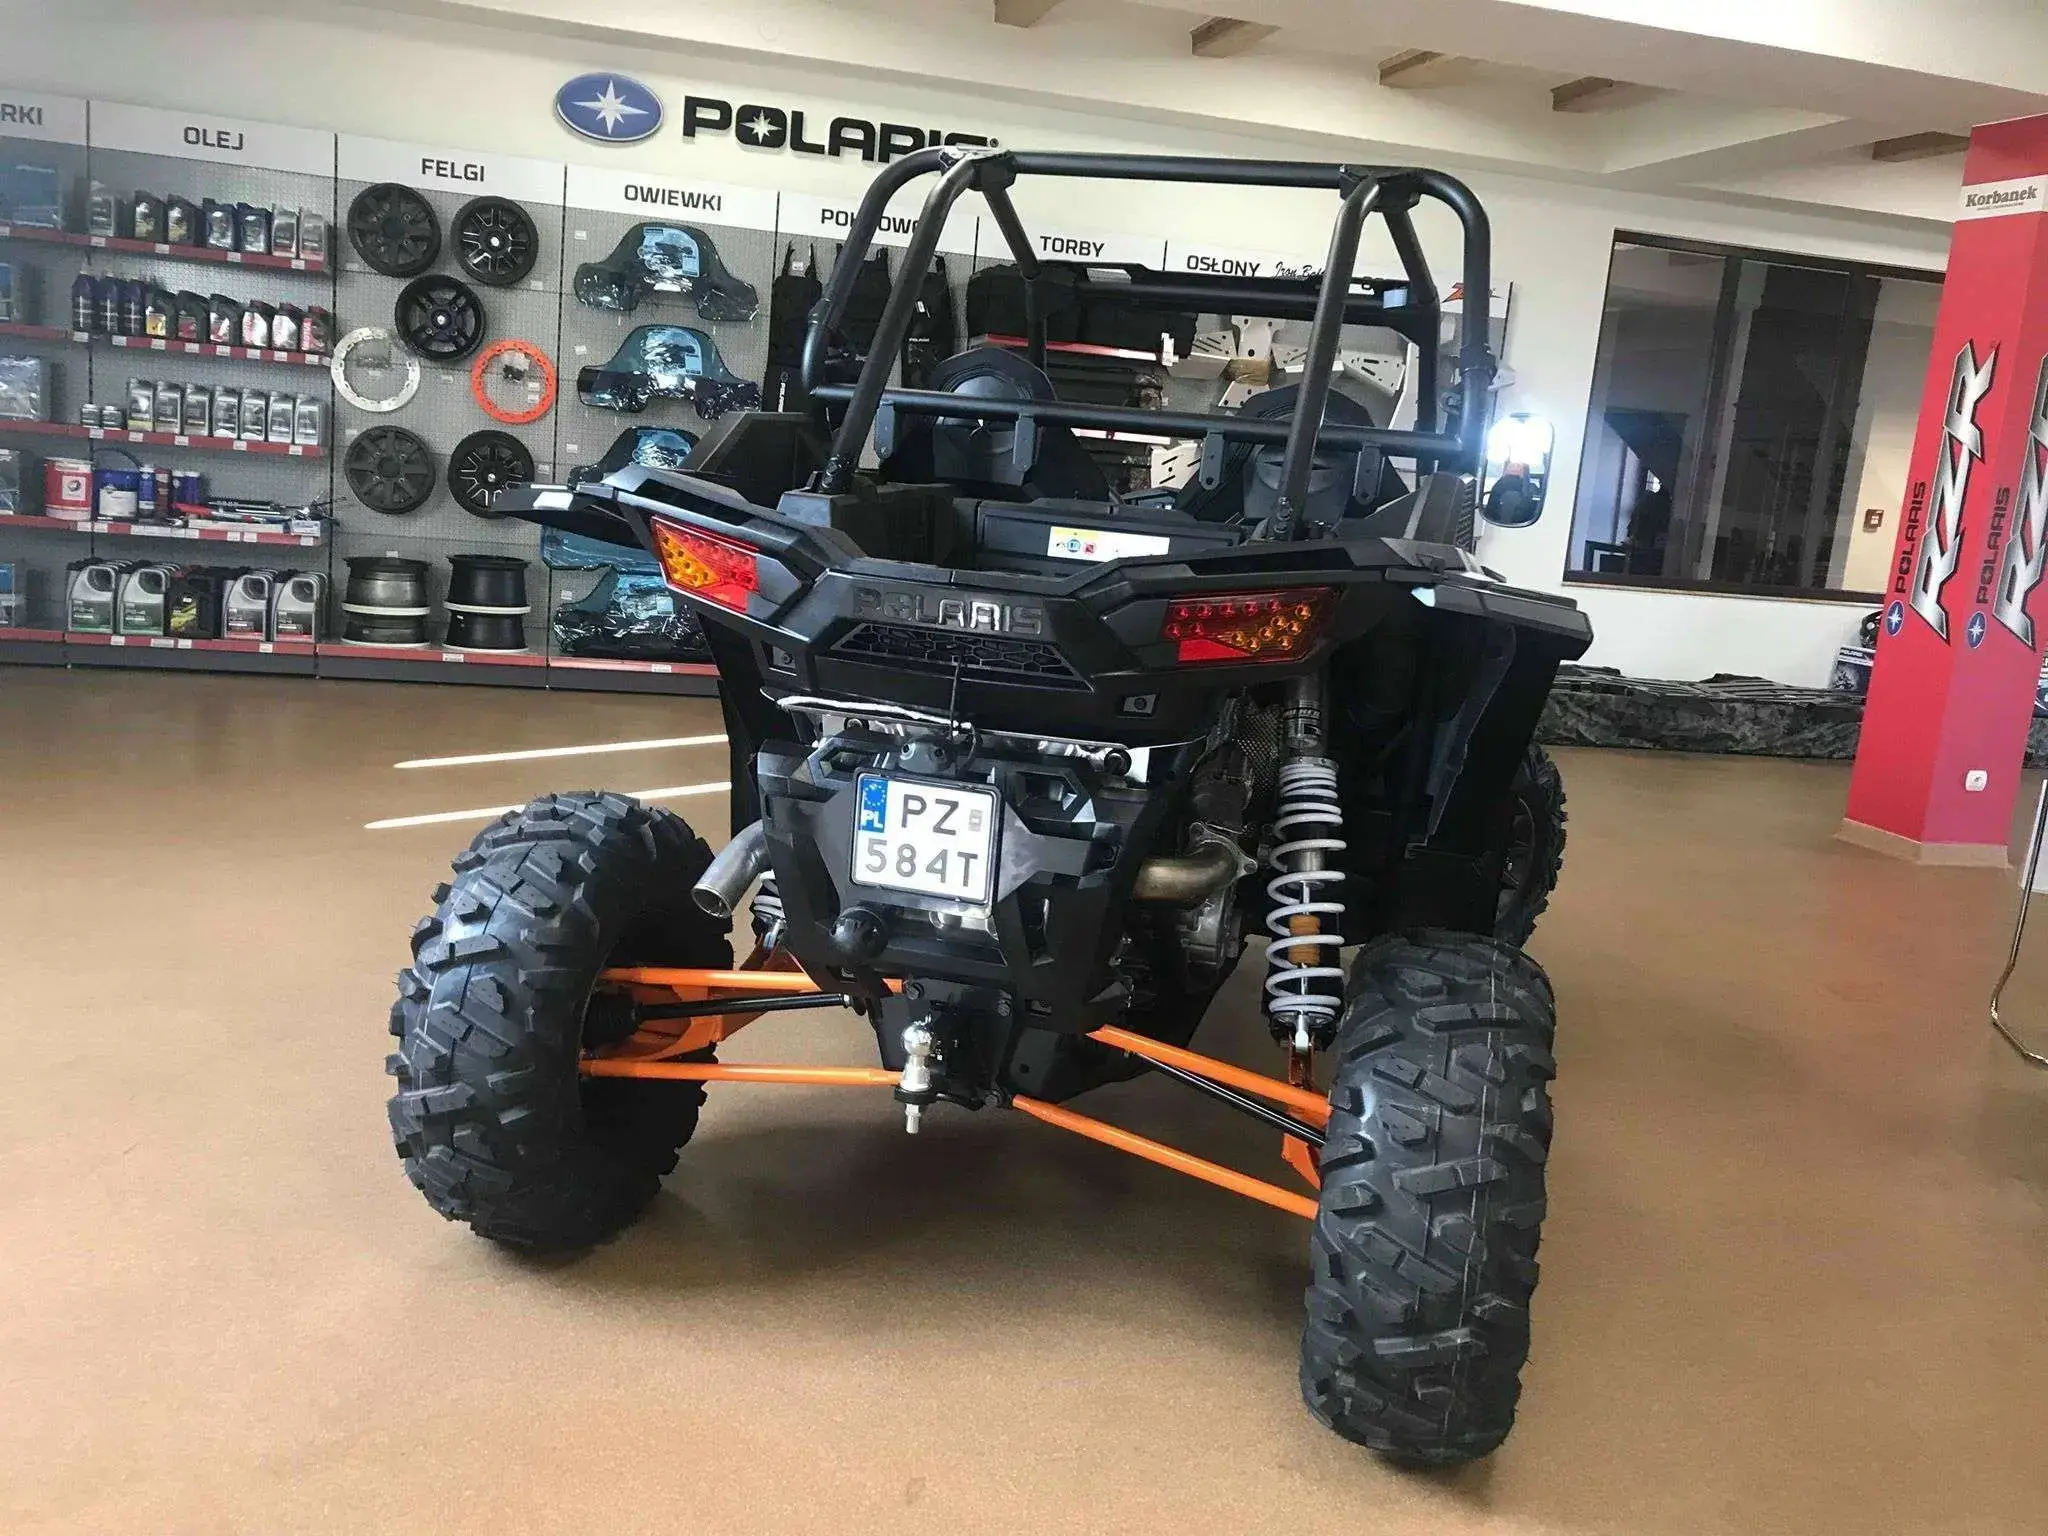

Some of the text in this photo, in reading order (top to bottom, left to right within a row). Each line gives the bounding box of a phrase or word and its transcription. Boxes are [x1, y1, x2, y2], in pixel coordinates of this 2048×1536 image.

[184, 126, 244, 151] OLEJ
[421, 158, 485, 183] FELGI
[623, 184, 722, 212] OWIEWKI
[1965, 185, 2038, 208] Korbanek
[1040, 236, 1105, 259] TORBY
[1186, 255, 1261, 278] OSŁONY
[1909, 338, 2001, 647] RZR
[1894, 481, 1927, 594] POLARIS
[1975, 487, 2011, 604] POLARIS
[853, 587, 1042, 634] POLARIS
[861, 809, 884, 829] PL
[901, 793, 960, 836] PZ
[865, 837, 979, 888] 584T
